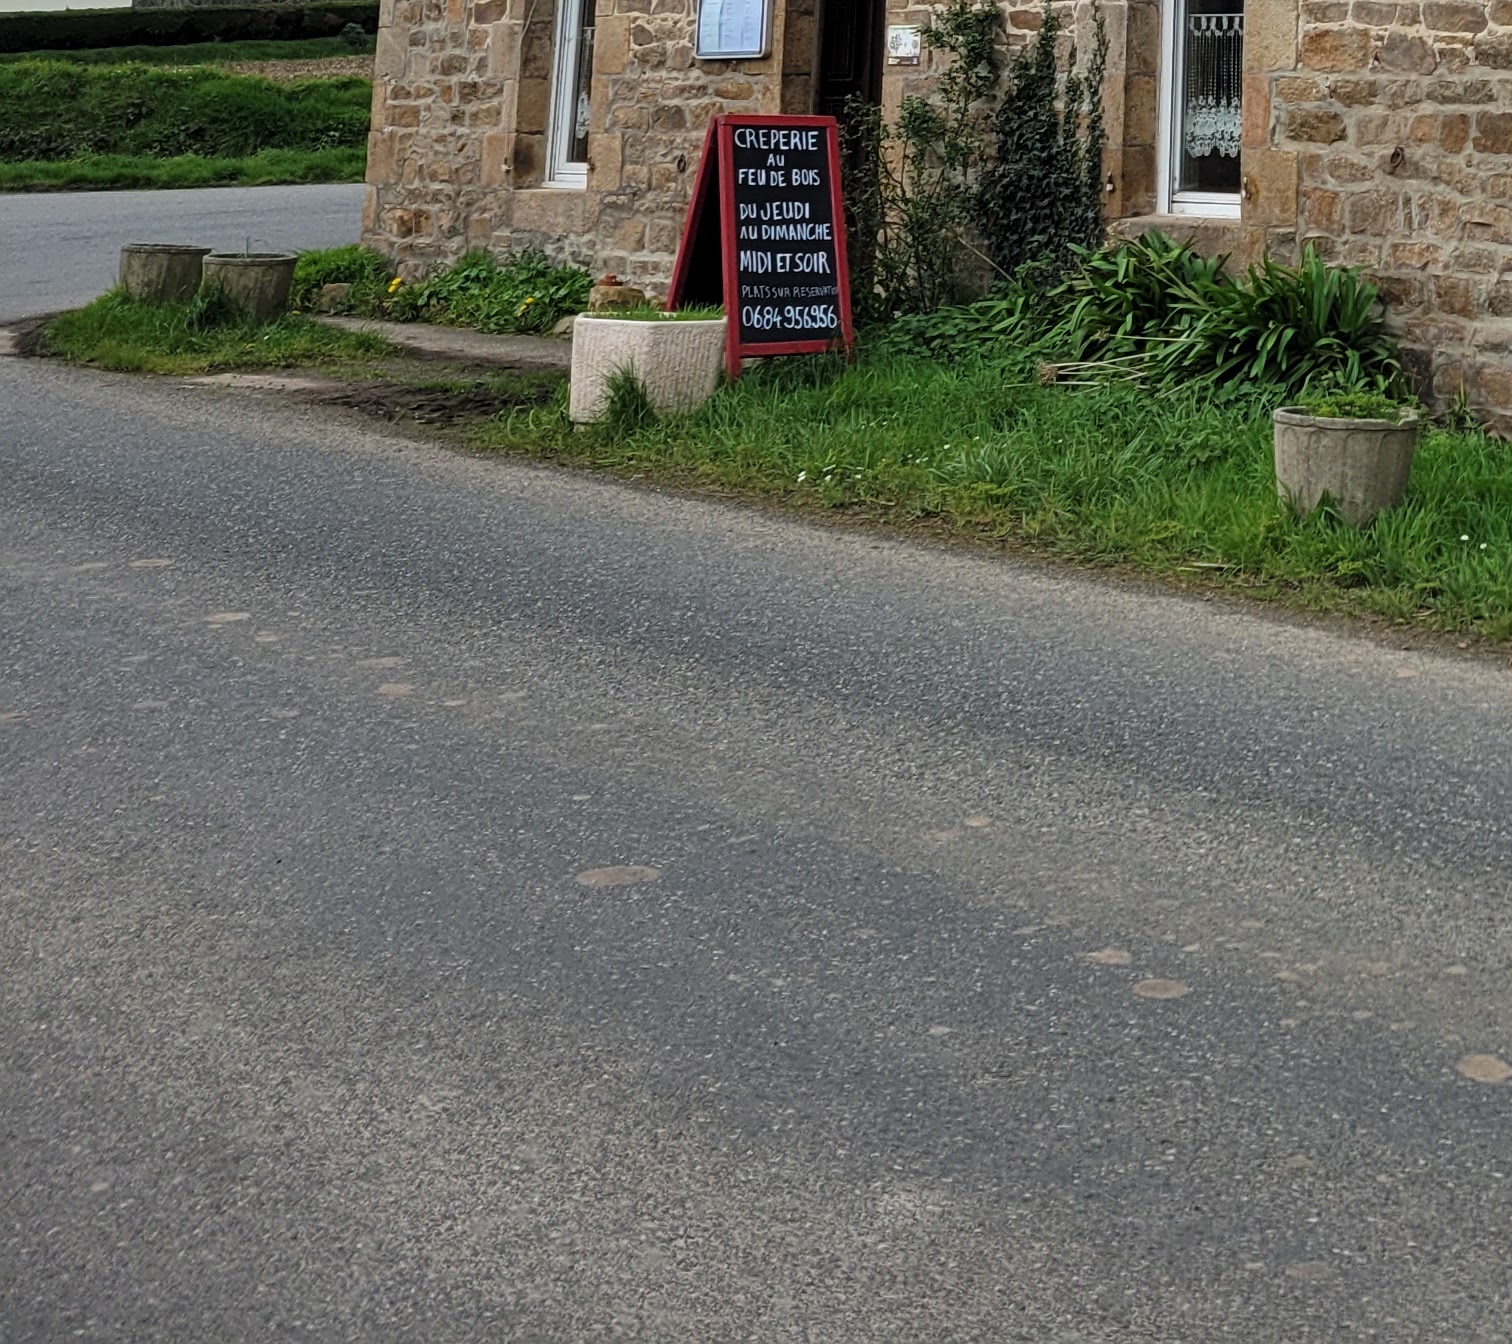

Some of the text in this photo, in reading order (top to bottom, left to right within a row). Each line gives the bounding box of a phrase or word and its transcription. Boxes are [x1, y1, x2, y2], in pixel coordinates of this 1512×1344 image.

[734, 128, 819, 151] CREPERIE
[766, 153, 785, 167] AU
[738, 168, 821, 187] FEU DE BOIS
[740, 201, 810, 221] DU JEUDI
[740, 223, 832, 241] AU DIMANCHE
[740, 250, 831, 274] MIDI ET SOIR
[741, 284, 771, 299] PLATS
[771, 286, 791, 299] SUR
